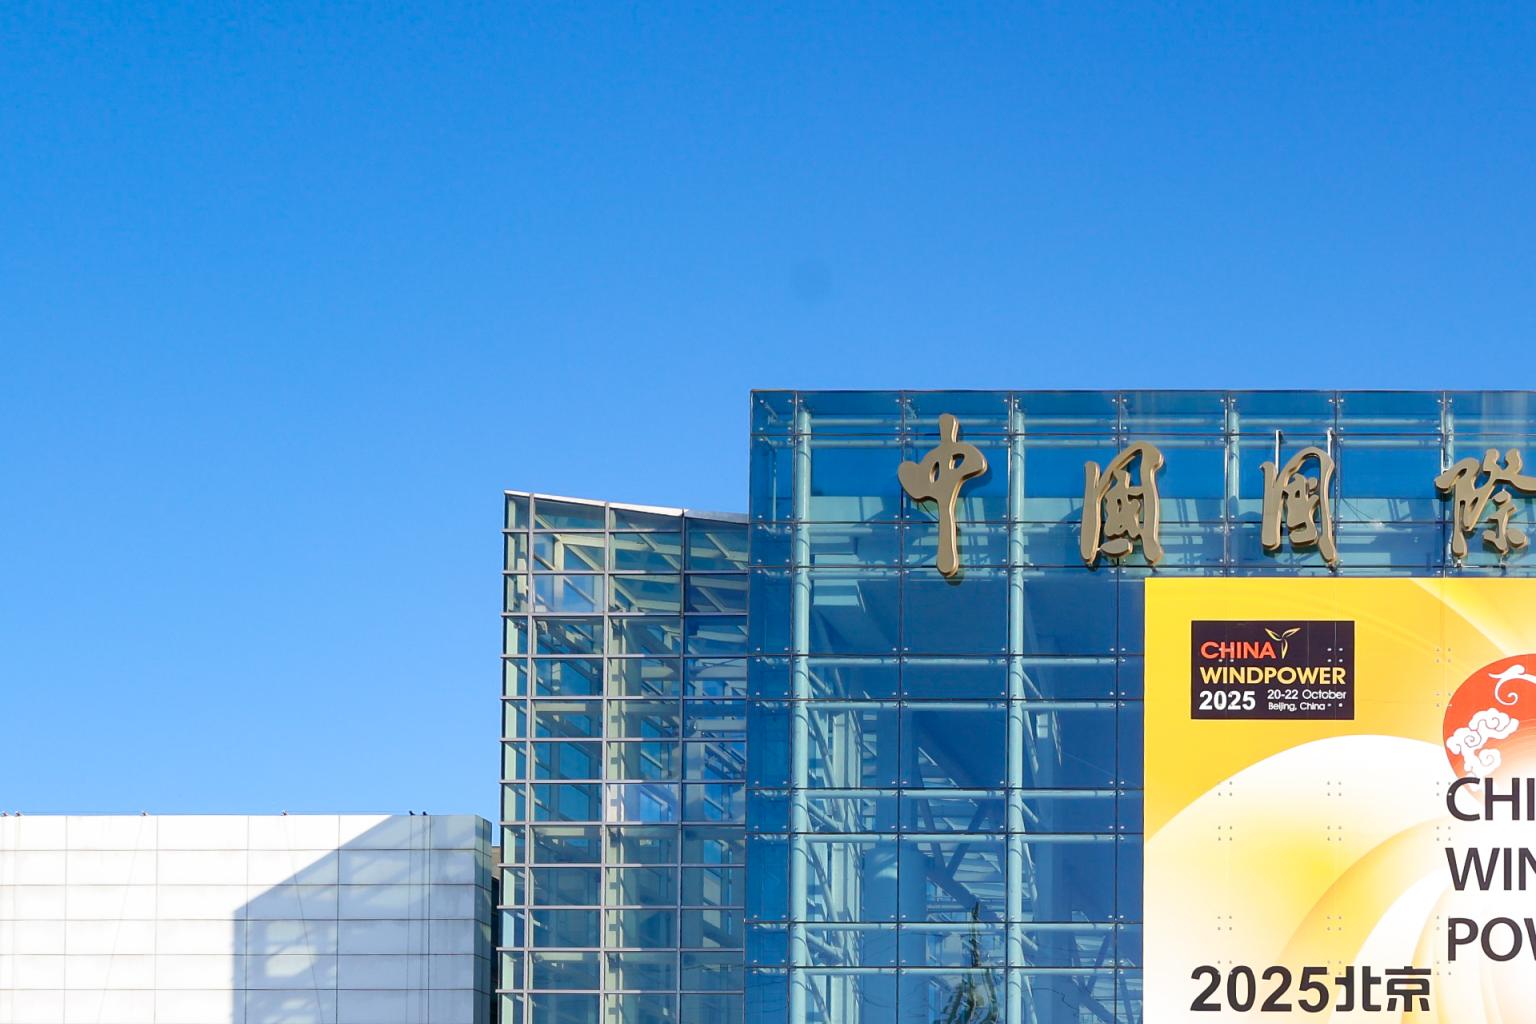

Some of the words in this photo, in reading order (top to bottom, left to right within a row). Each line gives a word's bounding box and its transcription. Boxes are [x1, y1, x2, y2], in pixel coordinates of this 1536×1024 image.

[1200, 640, 1277, 660] CHINA
[1200, 667, 1346, 685] WINDPOWER
[1199, 690, 1256, 711] 2025
[1267, 689, 1299, 700] 20-22
[1302, 689, 1346, 700] October
[1268, 702, 1297, 712] Beijing,
[1300, 702, 1325, 711] China
[1190, 965, 1432, 1013] 2025北京
